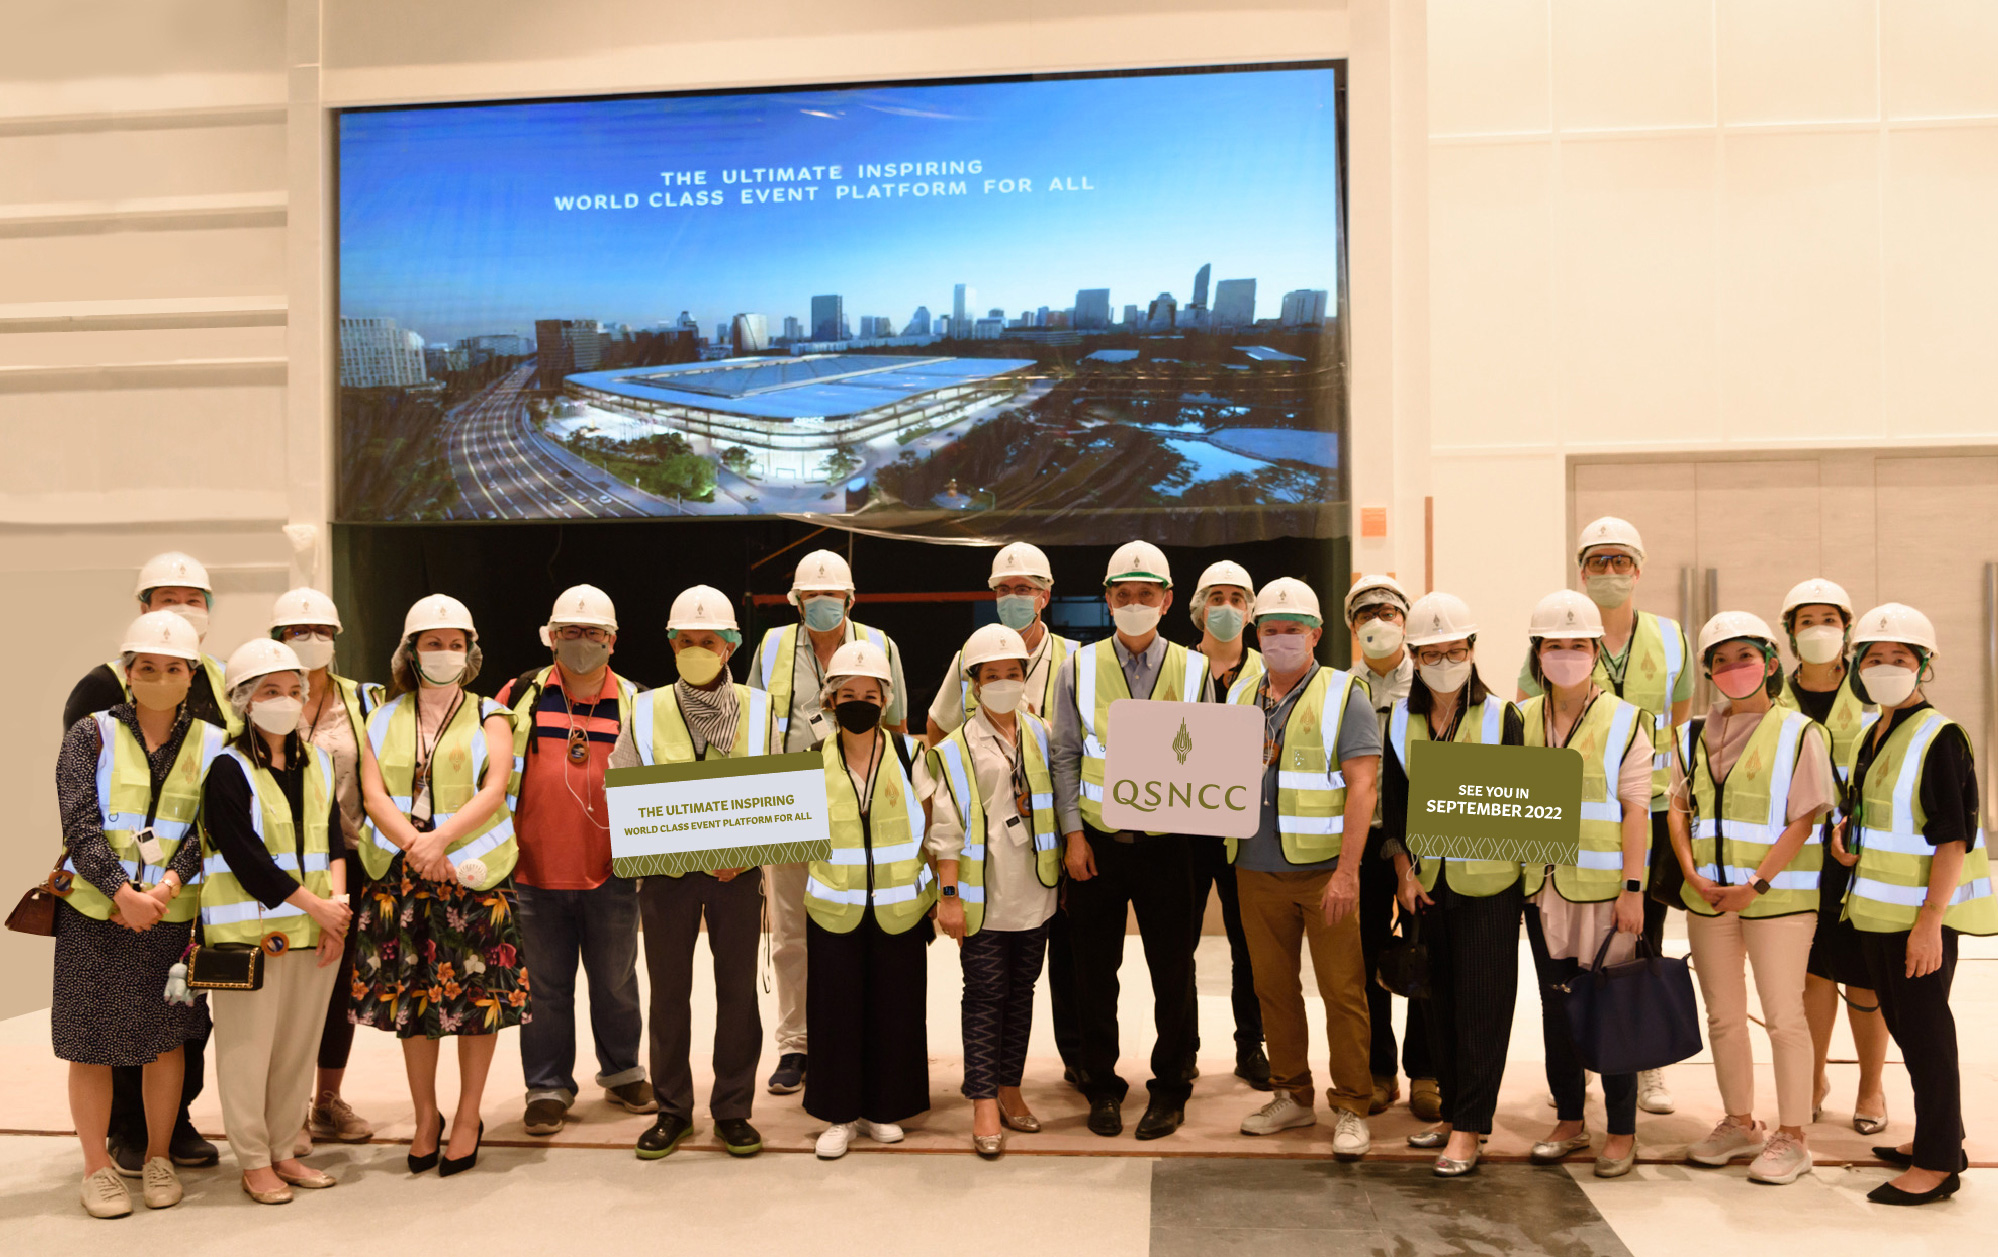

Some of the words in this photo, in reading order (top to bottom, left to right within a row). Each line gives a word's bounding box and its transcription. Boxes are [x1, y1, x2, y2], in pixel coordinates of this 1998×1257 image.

[661, 171, 707, 186] THE
[722, 165, 843, 184] ULTIMATE
[858, 160, 983, 179] INSPIRING
[554, 194, 639, 212] WORLD
[649, 190, 724, 208] CLASS
[741, 187, 819, 205] EVENT
[836, 181, 968, 200] PLATFORM
[984, 178, 1033, 194] FOR
[1048, 176, 1095, 192] ALL
[1113, 779, 1247, 812] QSNCC
[1458, 784, 1483, 797] SEE
[1485, 786, 1513, 799] YOU
[1515, 788, 1530, 799] IN
[638, 806, 664, 818] THE
[665, 800, 729, 816] ULTIMATE
[731, 794, 795, 810] INSPIRING
[1426, 799, 1522, 818] SEPTEMBER
[1524, 805, 1562, 820] 2022
[624, 825, 659, 836] WORLD
[660, 822, 690, 833] CLASS
[691, 819, 721, 830] EVENT
[723, 815, 773, 827] PLATFORM
[774, 813, 793, 823] FOR
[794, 811, 812, 821] ALL
